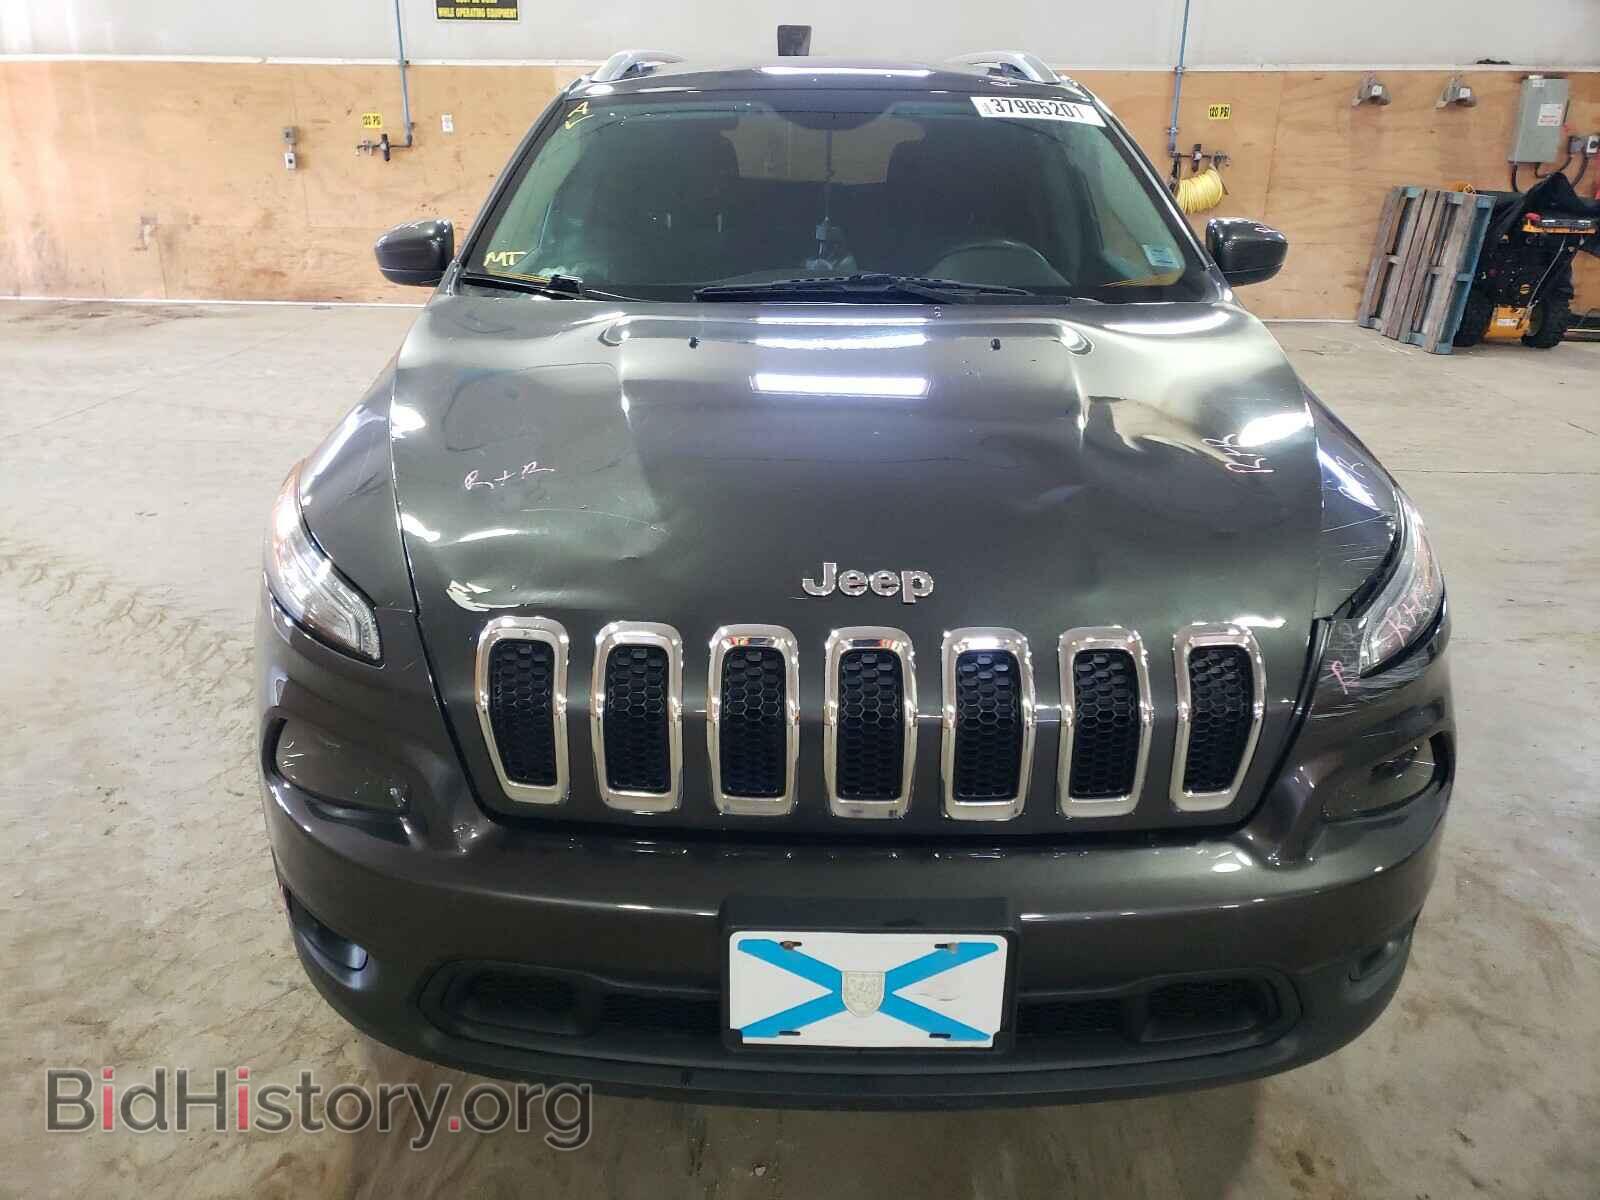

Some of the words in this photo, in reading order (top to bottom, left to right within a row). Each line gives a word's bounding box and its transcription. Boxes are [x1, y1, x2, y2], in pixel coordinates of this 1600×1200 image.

[989, 98, 1084, 119] 37965201
[483, 251, 528, 267] MT
[802, 562, 934, 603] Jeep
